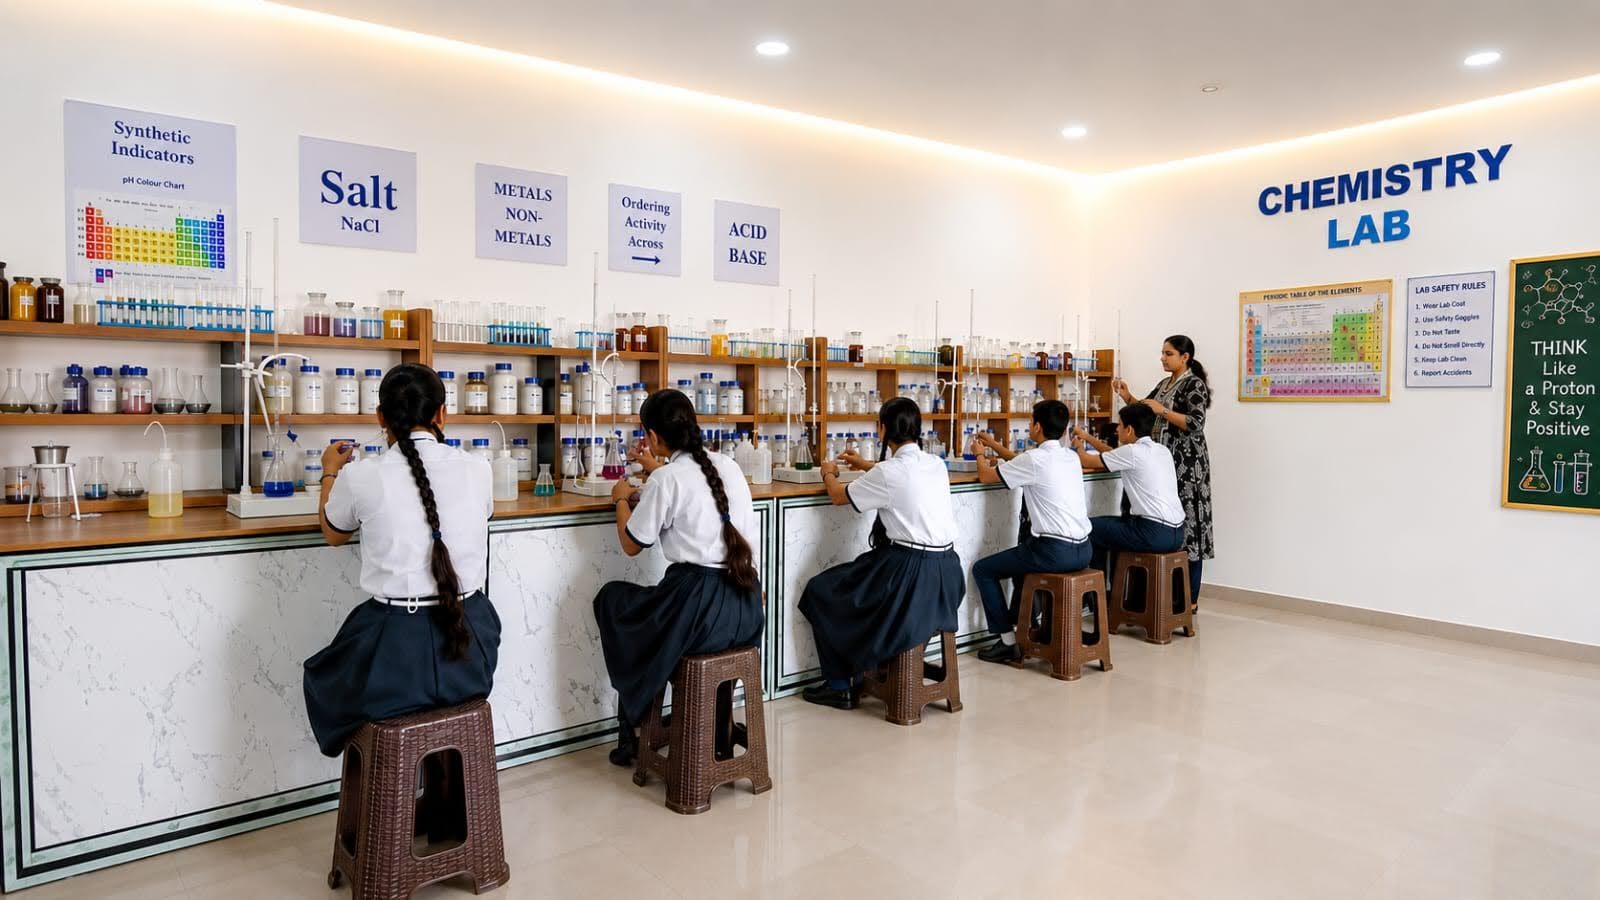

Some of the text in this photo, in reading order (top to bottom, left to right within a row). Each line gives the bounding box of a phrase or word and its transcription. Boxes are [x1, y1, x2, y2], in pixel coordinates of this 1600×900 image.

[114, 120, 191, 144] Synthetic
[112, 141, 194, 165] Indicators
[136, 177, 161, 187] Colour
[163, 181, 185, 190] Chart
[1258, 143, 1512, 216] CHEMISTRY
[321, 170, 398, 211] Salt
[494, 181, 552, 202] METALS
[506, 207, 543, 223] NON-
[622, 196, 671, 216] Ordering
[341, 216, 380, 233] NaCl
[625, 216, 667, 234] Activity
[729, 222, 767, 240] ACID
[1328, 209, 1411, 249] LAB
[495, 229, 552, 248] METALS
[628, 235, 664, 250] Across
[729, 247, 767, 266] BASE
[1330, 286, 1362, 295] ELEMENTS
[1415, 282, 1487, 294] LAB SAFETY RULES
[1530, 339, 1588, 356] THINK
[1543, 361, 1577, 376] Like
[1525, 380, 1596, 396] a Proton
[1529, 400, 1585, 420] & Stay
[1526, 420, 1590, 437] Positive
